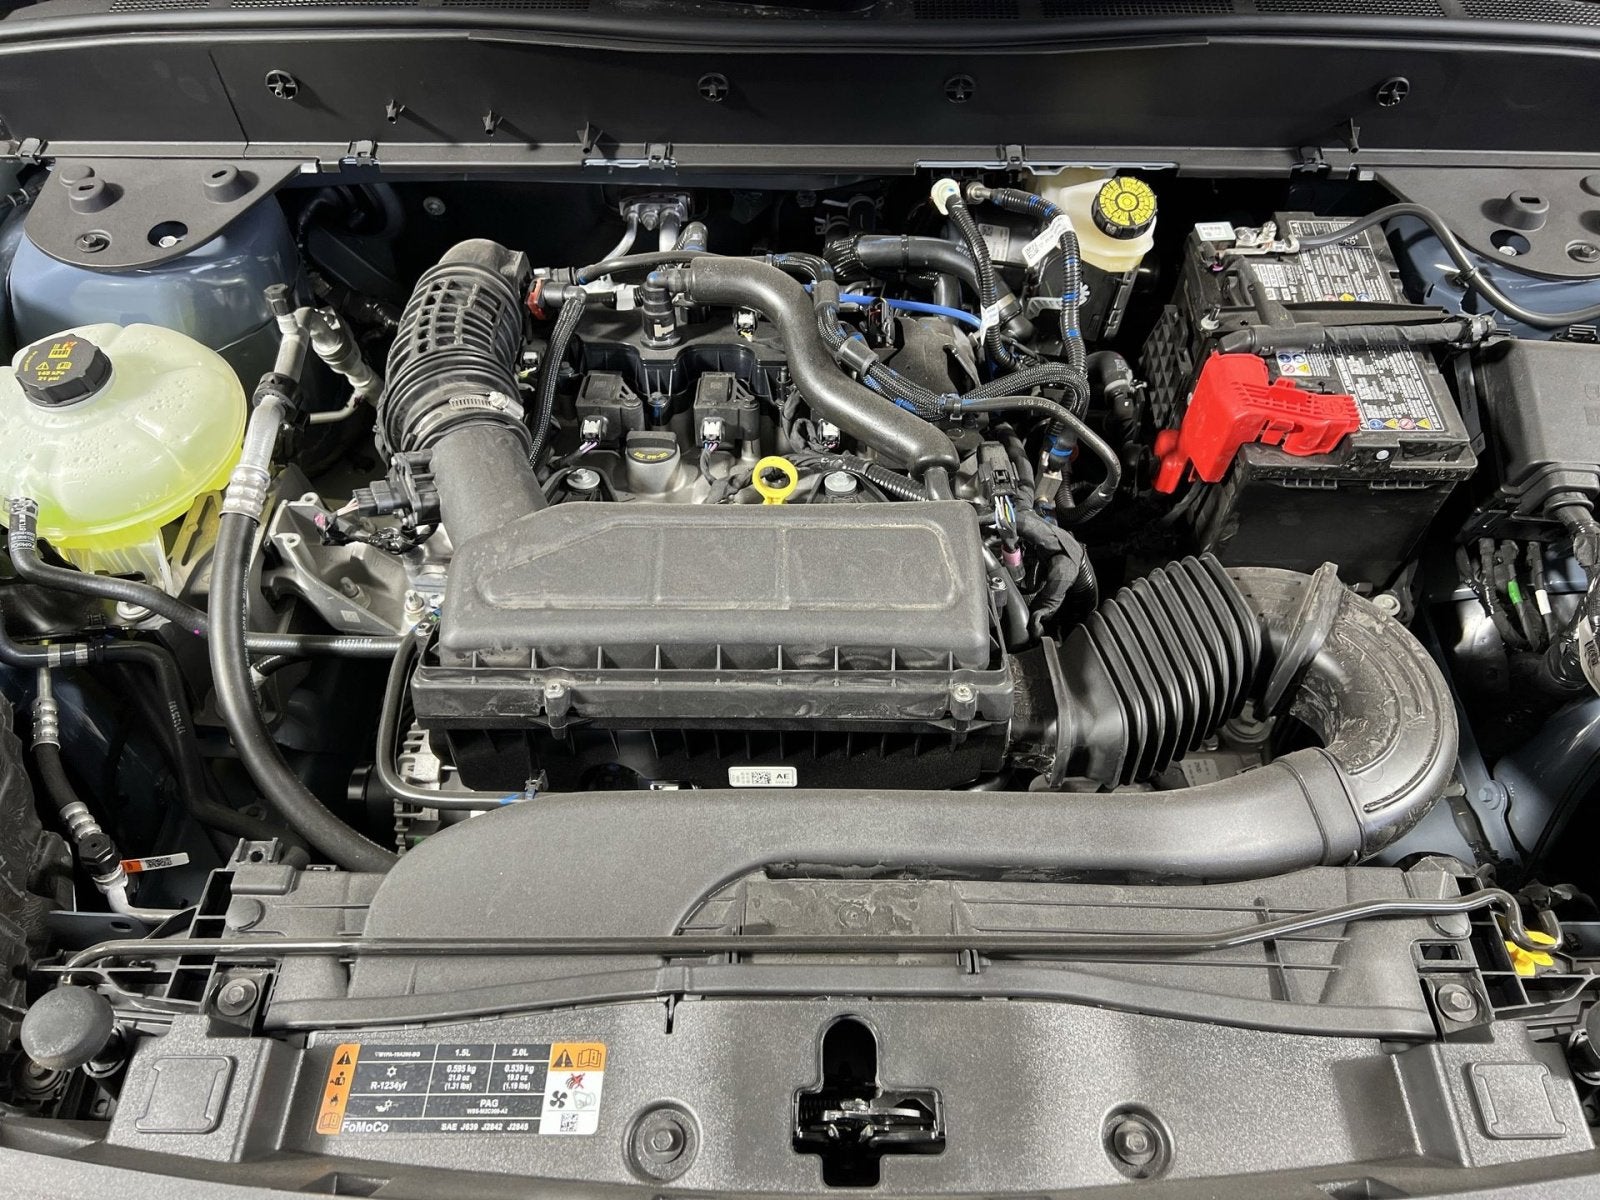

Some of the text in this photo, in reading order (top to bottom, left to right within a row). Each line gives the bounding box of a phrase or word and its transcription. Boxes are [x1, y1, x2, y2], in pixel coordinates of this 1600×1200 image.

[455, 1048, 471, 1057] 1.5L
[512, 1048, 529, 1057] 2.0L
[466, 1064, 477, 1075] kg
[524, 1064, 535, 1075] kg
[370, 1081, 408, 1091] R-1234yf
[480, 1098, 499, 1108] PAG
[341, 1121, 389, 1133] FoMoCo
[440, 1123, 458, 1131] SAE
